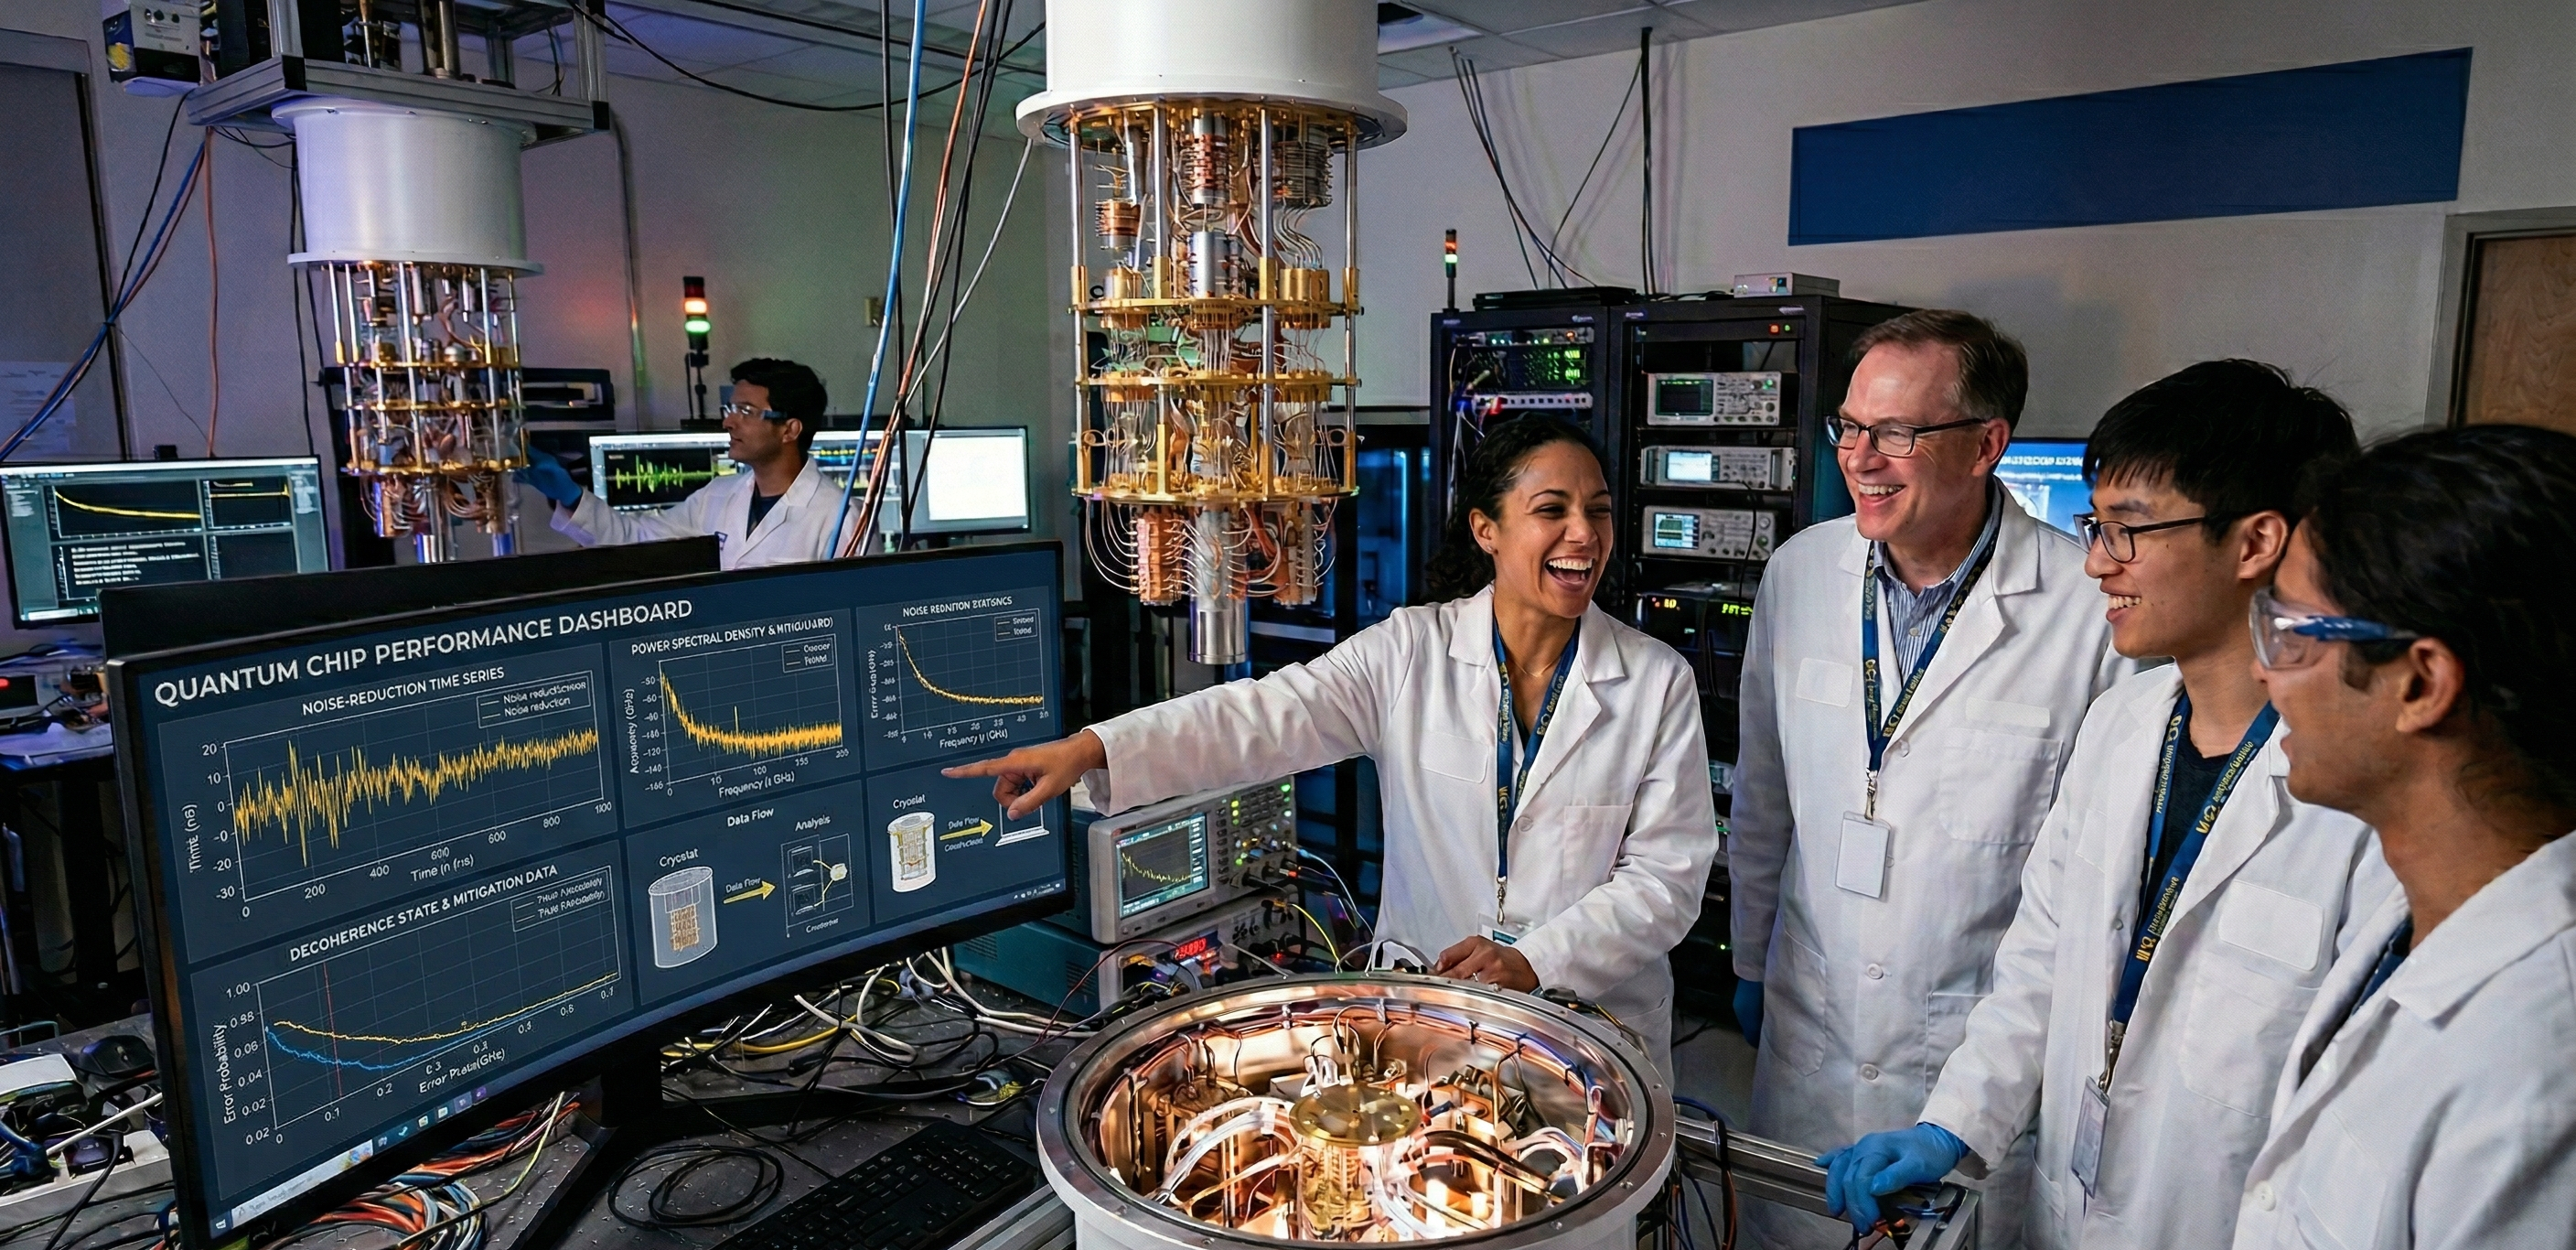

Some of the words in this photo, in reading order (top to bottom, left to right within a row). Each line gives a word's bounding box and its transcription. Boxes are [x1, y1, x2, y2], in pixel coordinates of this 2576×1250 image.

[631, 641, 671, 655] POWER
[671, 631, 724, 650] SPECTRAL
[724, 625, 766, 641] DENSITY
[767, 624, 777, 636] &
[155, 659, 299, 708] QUANTUM
[306, 647, 367, 677] CHIP
[375, 619, 553, 665] PERFORMANCE
[559, 599, 693, 635] DASHBOARD
[302, 680, 427, 716] NOISE-REDUCTION
[429, 673, 460, 693] TIME
[463, 666, 505, 685] SERIES
[201, 743, 218, 756] 20
[207, 772, 221, 784] 10
[217, 801, 225, 812] 0
[542, 815, 561, 828] 800
[727, 814, 750, 827] Data
[214, 831, 228, 842] -0
[488, 830, 507, 844] 600
[212, 858, 231, 872] -20
[370, 865, 390, 878] 400
[411, 867, 438, 883] Time
[216, 886, 235, 900] -30
[305, 884, 326, 899] 200
[242, 906, 251, 918] 0
[290, 915, 395, 962] DECOHERENCE
[398, 901, 440, 925] STATE
[442, 898, 451, 911] &
[453, 873, 524, 908] MITIGATION
[526, 865, 558, 884] DATA
[226, 981, 251, 998] 1.00
[238, 1071, 263, 1087] 0.04
[419, 1073, 448, 1094] Error
[242, 1099, 266, 1116] 0.02
[324, 1108, 340, 1121] 0.1
[276, 1134, 284, 1144] 0
